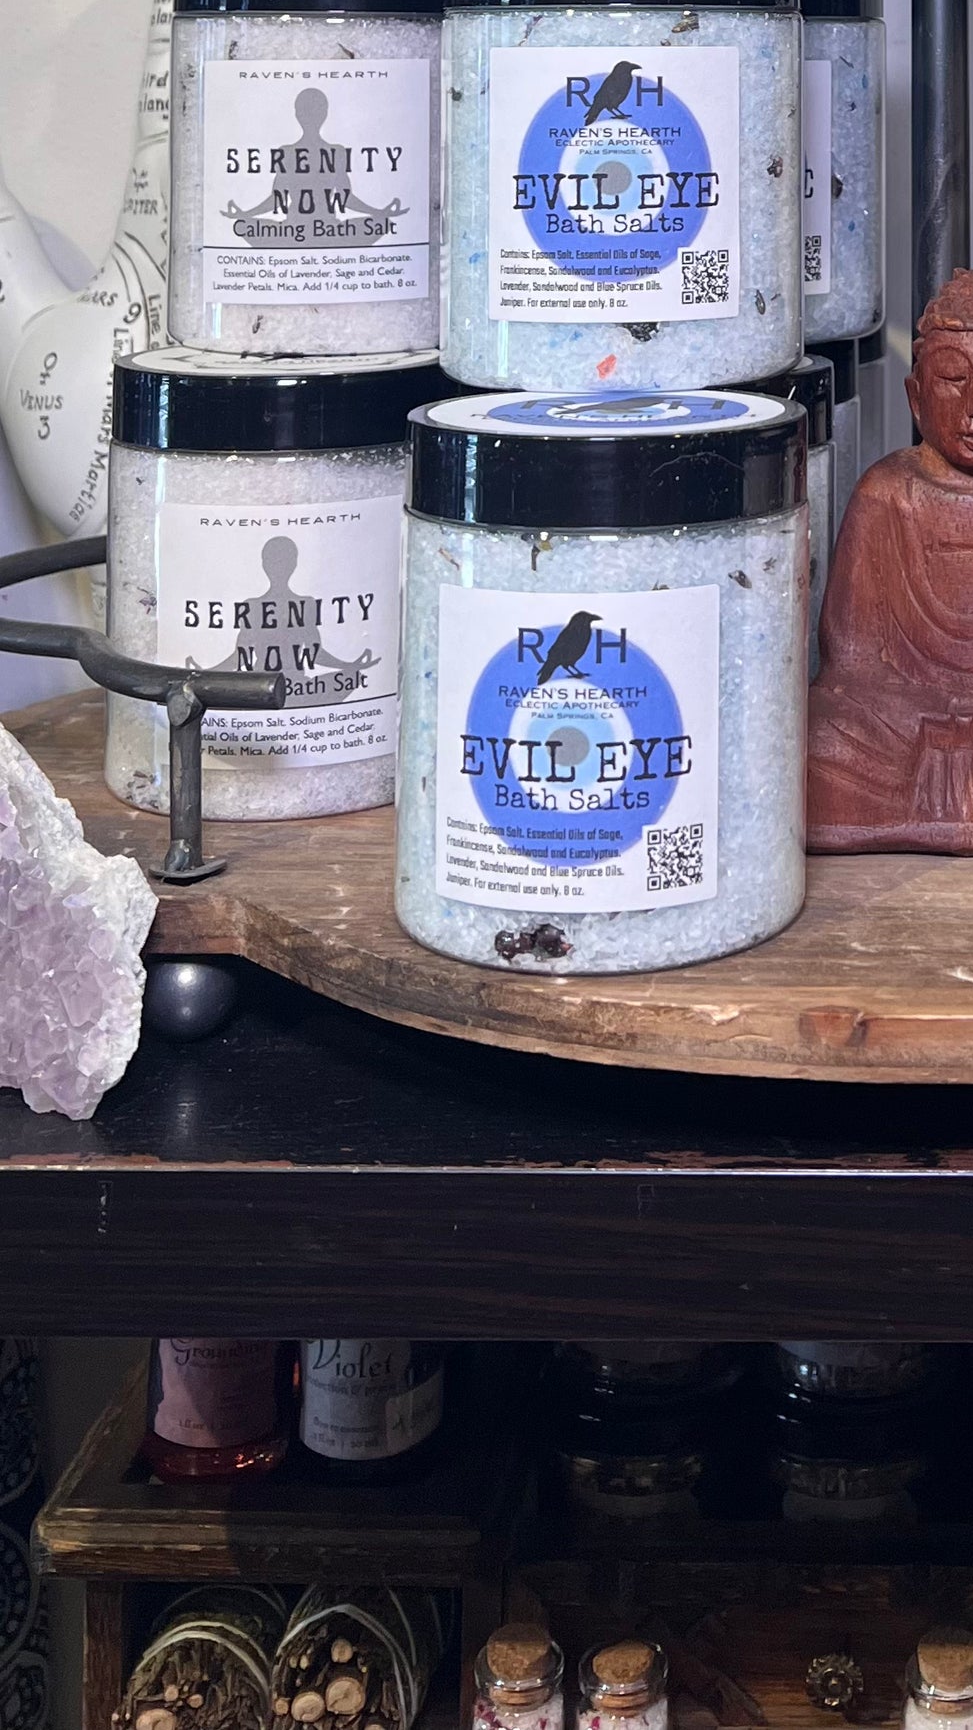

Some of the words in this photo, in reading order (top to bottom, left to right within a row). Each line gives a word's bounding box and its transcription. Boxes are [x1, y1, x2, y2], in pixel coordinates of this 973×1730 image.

[239, 71, 311, 79] RAVEN'S
[318, 71, 389, 79] HEARTH
[566, 76, 592, 107] R
[636, 76, 664, 106] H
[549, 127, 613, 138] RAVEN'S
[618, 126, 681, 137] HEARTH
[226, 147, 403, 174] SERENITY
[273, 188, 350, 214] NOW
[512, 173, 620, 211] EVIL
[637, 171, 719, 210] EYE
[232, 219, 305, 242] Calming
[313, 221, 356, 237] Bath
[363, 218, 397, 236] Salt
[545, 214, 605, 234] Bath
[613, 213, 684, 233] Salts
[217, 256, 266, 265] CONTAINS:
[269, 256, 298, 266] Epsom
[322, 255, 357, 265] Sodium
[223, 269, 256, 278] Essential
[258, 269, 276, 279] Oils
[278, 269, 288, 278] of
[335, 269, 356, 280] Sage
[358, 268, 375, 277] and
[212, 282, 245, 291] Lavender
[302, 282, 322, 291] Add
[325, 282, 339, 291] 1/4
[341, 283, 359, 293] cup
[361, 282, 371, 290] to
[397, 280, 403, 288] 8
[19, 388, 63, 410] VENUS
[200, 518, 280, 527] RAVEN'S
[287, 513, 361, 526] HEARTH
[184, 593, 374, 629] SERENITY
[517, 627, 545, 664] R
[595, 628, 627, 664] H
[236, 643, 320, 671] NOW
[333, 672, 368, 691] Salt
[498, 686, 569, 700] RAVEN'S
[575, 685, 647, 699] HEARTH
[231, 718, 263, 728] Epsom
[290, 716, 326, 727] Sodium
[208, 745, 237, 756] Petals.
[240, 746, 264, 756] Mica.
[268, 744, 289, 755] Add
[292, 744, 307, 753] 1/4
[310, 743, 328, 754] cup
[330, 741, 341, 750] to
[344, 738, 365, 749] bath.
[368, 735, 374, 745] 8
[460, 734, 576, 783] EVIL
[596, 736, 692, 783] EYE
[494, 784, 558, 811] Bath
[569, 788, 650, 810] Salts
